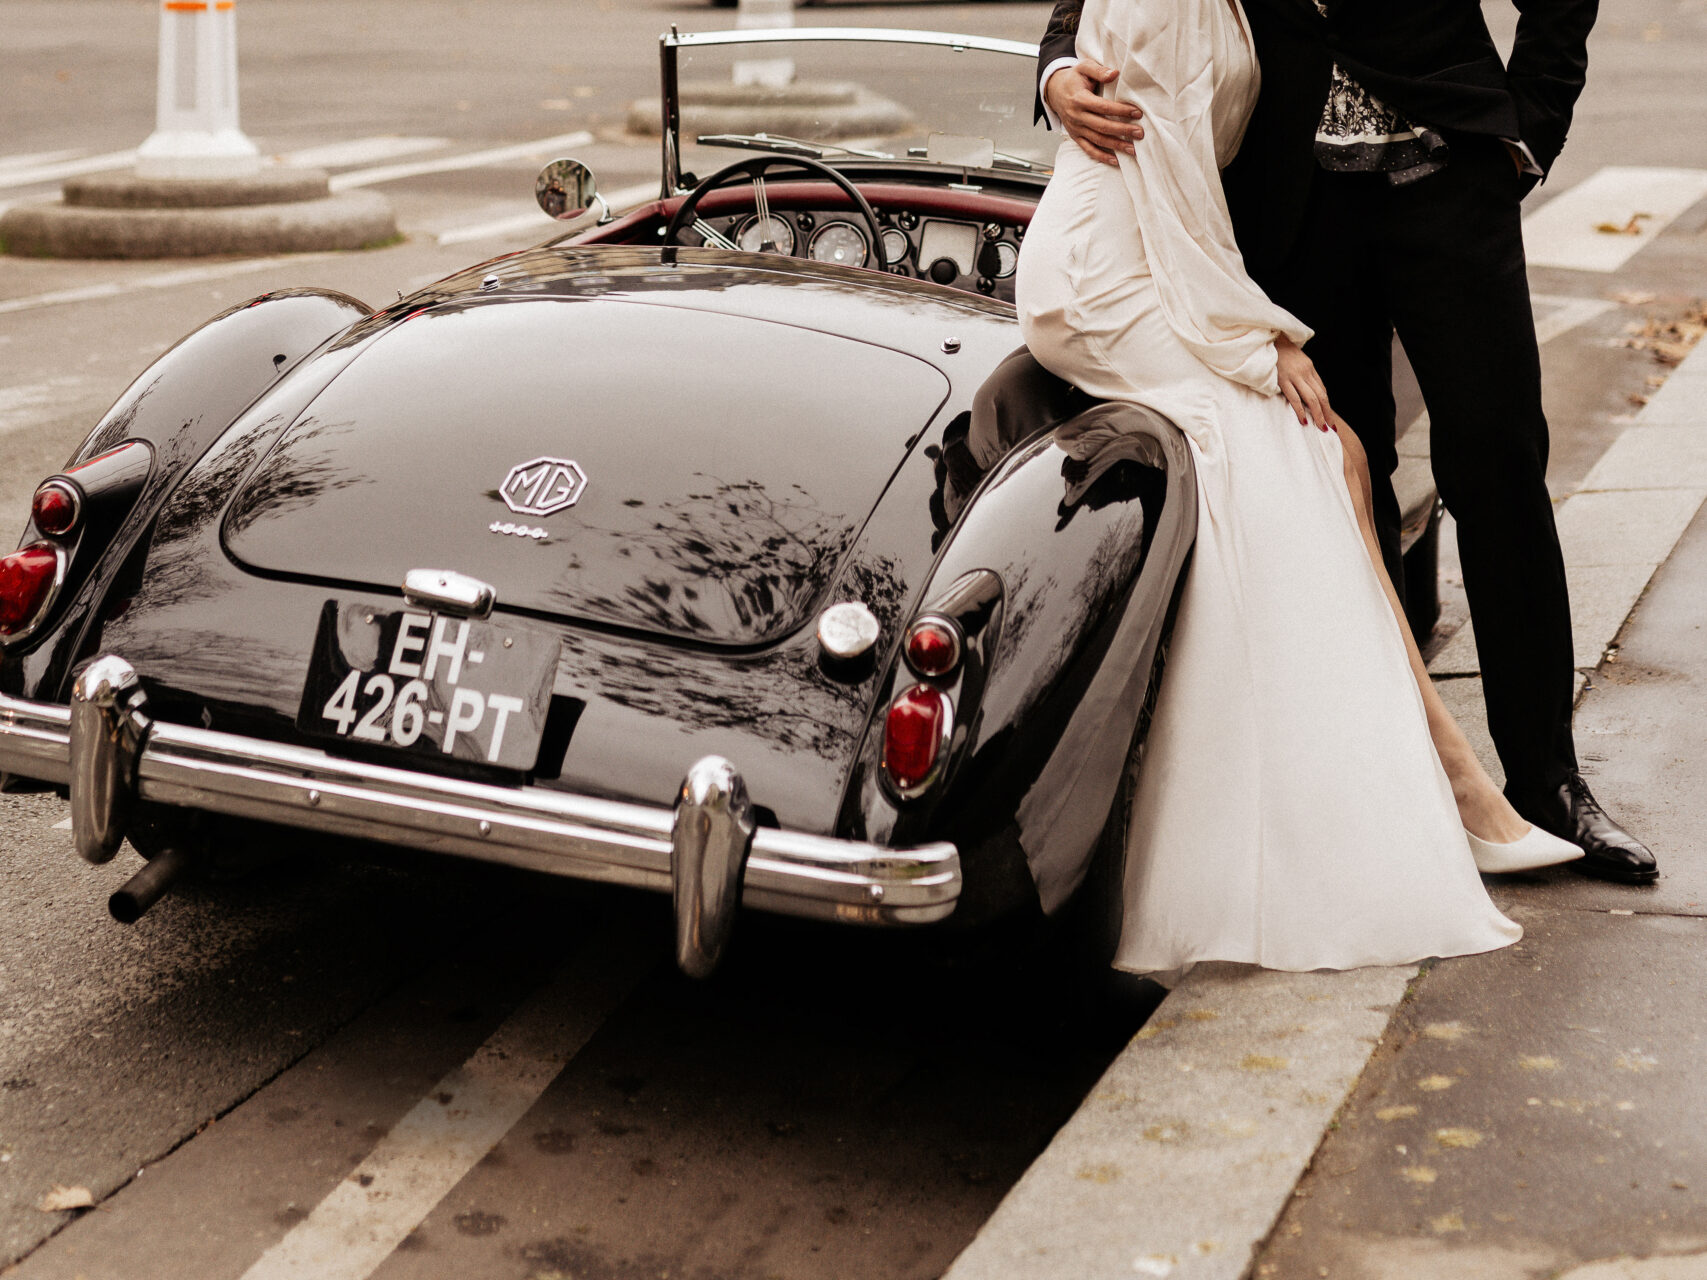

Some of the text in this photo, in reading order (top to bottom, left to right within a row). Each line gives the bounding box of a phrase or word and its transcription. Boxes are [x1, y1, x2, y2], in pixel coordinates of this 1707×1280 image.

[509, 463, 576, 509] MG
[388, 613, 485, 685] EH-
[321, 669, 524, 763] 426-PT
